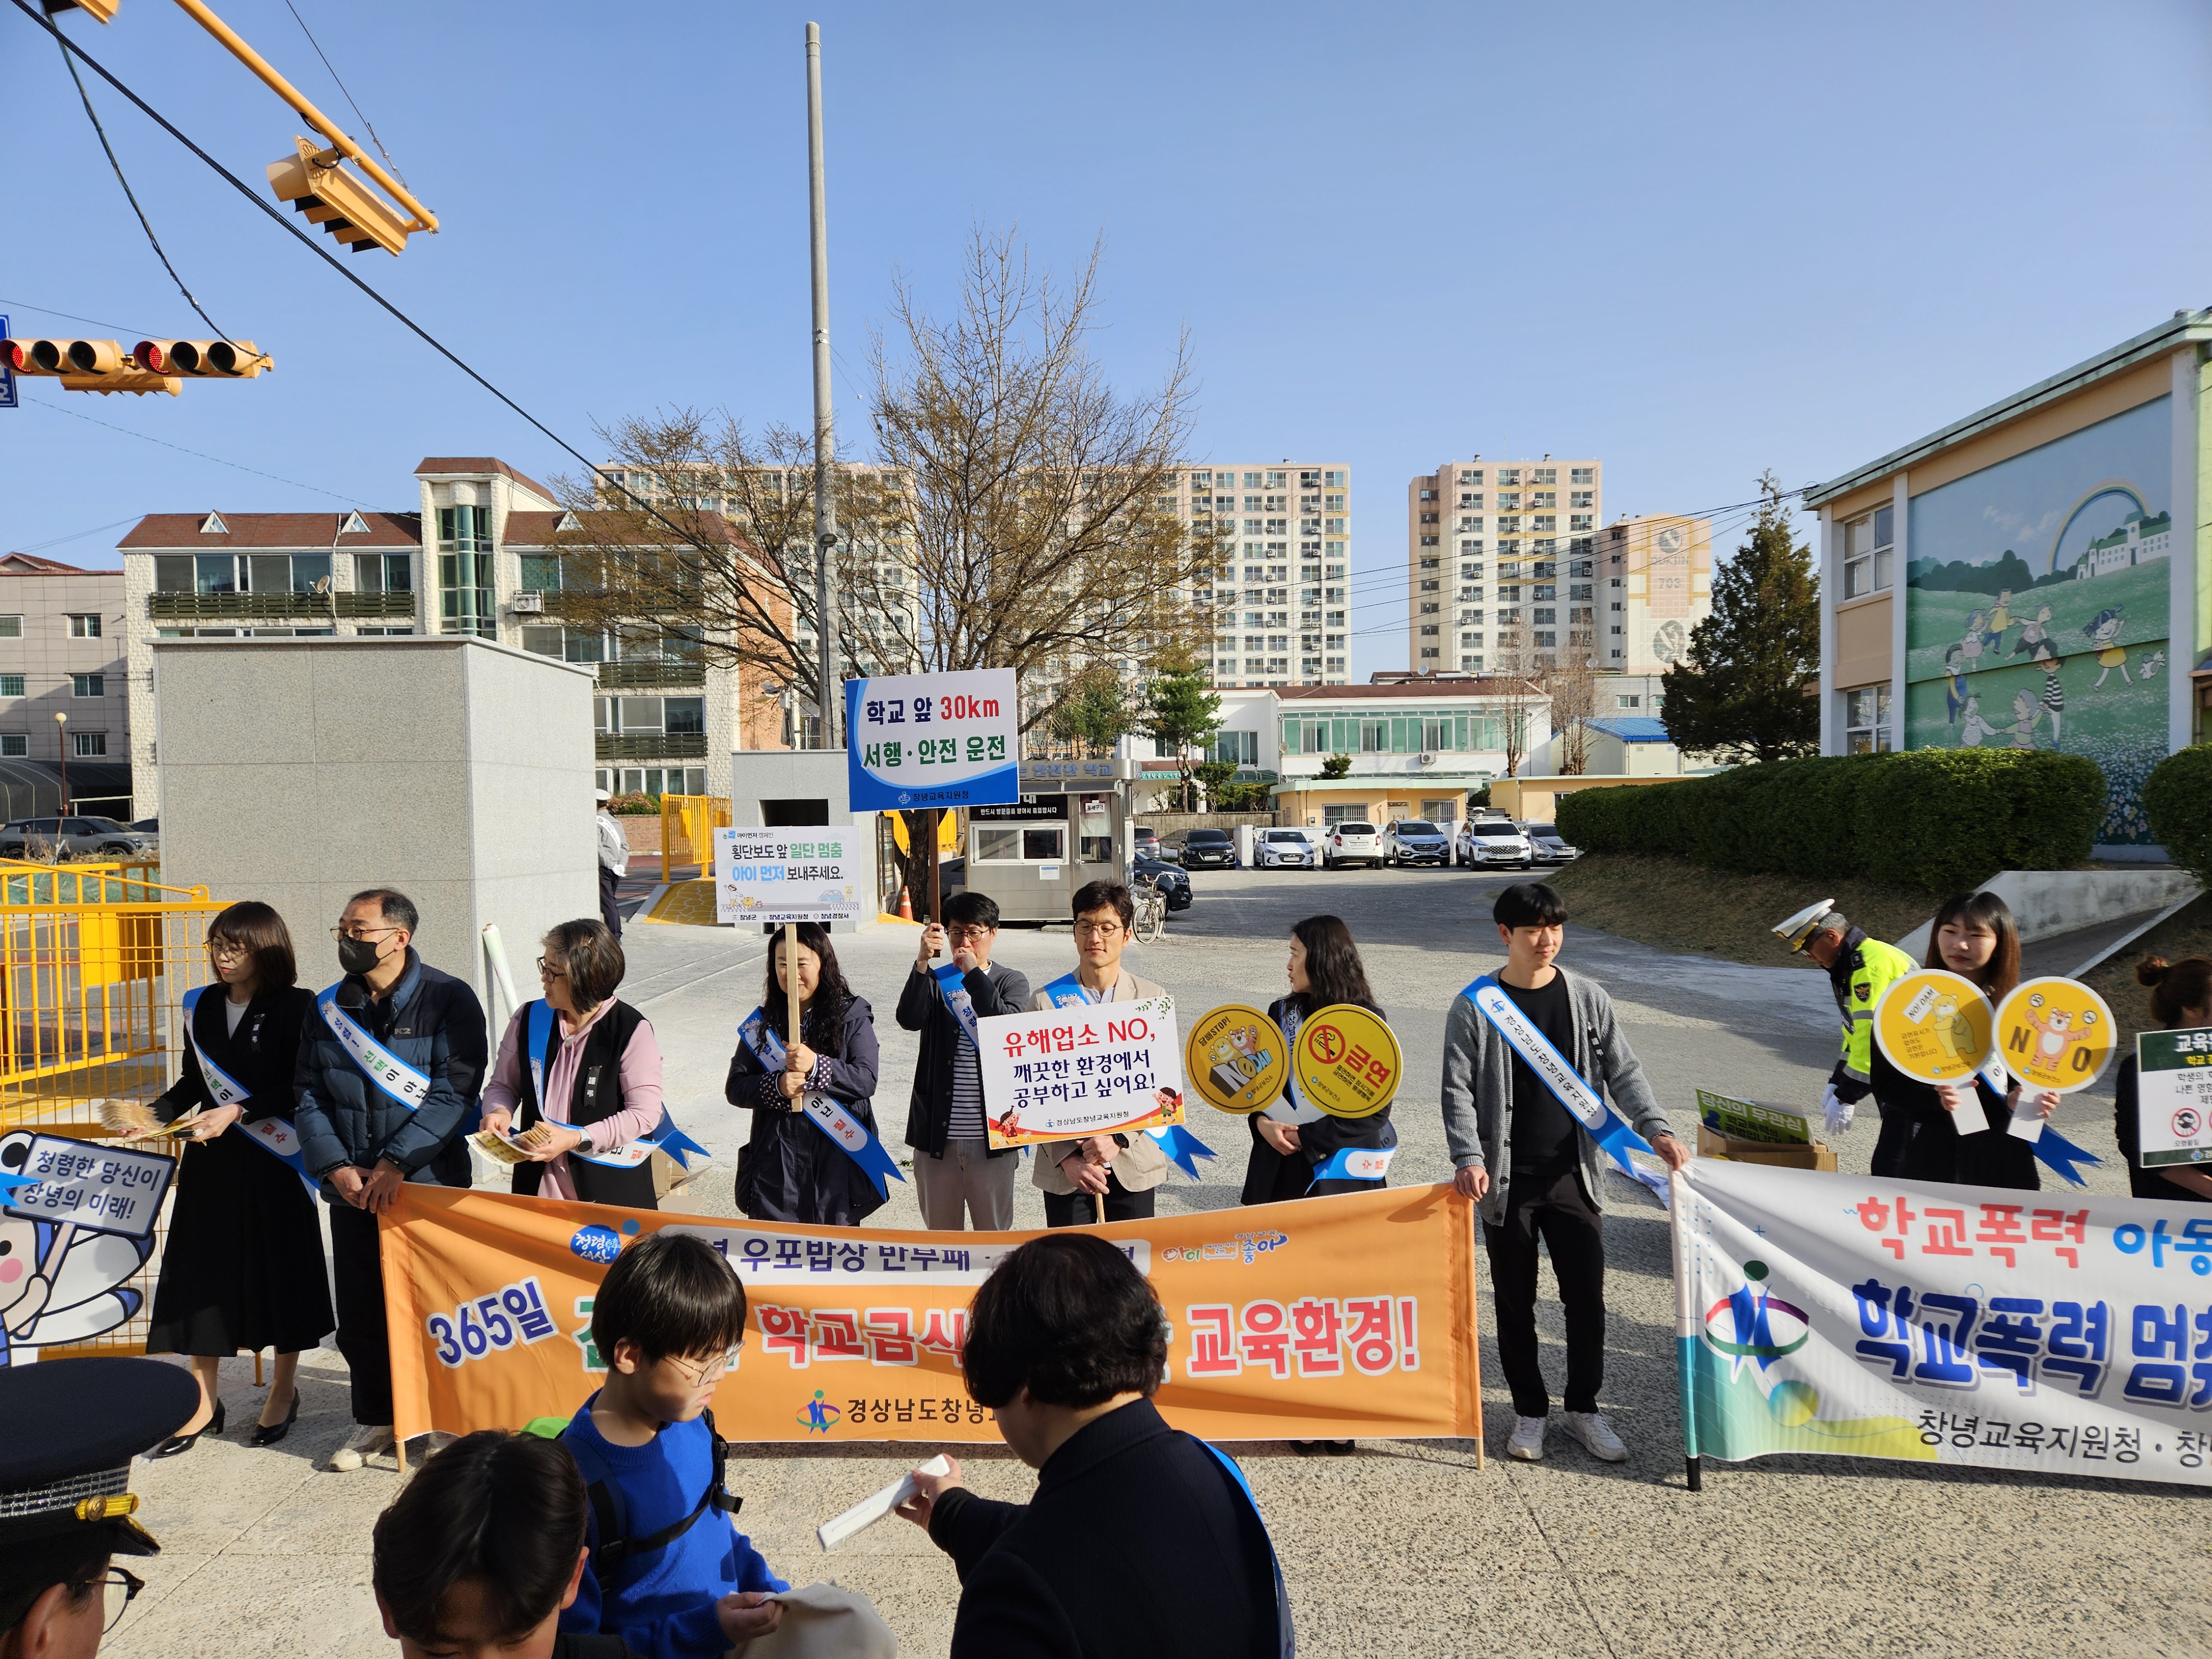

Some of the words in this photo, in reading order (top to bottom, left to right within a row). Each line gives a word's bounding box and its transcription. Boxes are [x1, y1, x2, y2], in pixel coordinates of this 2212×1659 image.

[1659, 578, 1681, 589] 703
[867, 700, 905, 725] 학교
[914, 697, 932, 723] 앞
[941, 695, 999, 719] 30km
[967, 735, 1005, 762] 운전
[1034, 764, 1077, 778] 안전한
[1084, 763, 1113, 777] 학교
[913, 791, 969, 801] 창녕교육지원청
[732, 844, 774, 860] 횡단보도
[776, 844, 787, 859] 앞
[790, 843, 815, 858] 일단
[818, 842, 842, 858] 멈춤
[732, 866, 757, 881] 아이
[760, 865, 785, 881] 먼저
[787, 865, 844, 881] 보내주세요.
[1921, 988, 1936, 1005] DAM
[1003, 1024, 1099, 1057] 유해업소
[1108, 1018, 1156, 1042] NO,
[1901, 1029, 1931, 1039] 금연표시가
[1504, 1014, 1597, 1117] 경상남도창녕교육지원청
[1908, 1048, 1937, 1060] 기본입니다
[2186, 1055, 2205, 1066] 학교
[1013, 1060, 1070, 1083] 깨끗한
[1076, 1049, 1150, 1077] 환경에서
[1344, 1044, 1391, 1089] 금연
[1941, 1061, 1971, 1072] 창녕군보건소
[2177, 1071, 2204, 1082] 학생의
[1251, 1075, 1273, 1094] 창녕군보건소
[1333, 1069, 1353, 1087] 금연하면
[2176, 1084, 2194, 1094] 나쁜
[1013, 1081, 1088, 1108] 공부하고
[1094, 1073, 1155, 1098] 싶어요!
[1317, 1081, 1340, 1102] 창녕군보건소
[811, 1096, 833, 1118] 아닌
[833, 1118, 855, 1140] 필수
[1056, 1110, 1129, 1126] 경상남도창녕교육지원청
[1700, 1092, 1747, 1118] 당신의
[1752, 1108, 1802, 1131] 무관심
[260, 1122, 287, 1144] 필수
[1726, 1114, 1778, 1136] 학교폭력의
[37, 1150, 95, 1180] 청렴한
[101, 1161, 161, 1191] 당신이
[88, 1193, 136, 1220] 미래!
[1857, 1196, 2090, 1269] 학교폭력
[580, 1249, 611, 1263] 세상
[740, 1238, 868, 1272] 우포밥상
[878, 1244, 971, 1272] 반부패
[1241, 1234, 1288, 1264] 좋아
[429, 1281, 555, 1365] 365일
[1191, 1300, 1416, 1375] 교육환경!
[1852, 1279, 2111, 1396] 학교폭력
[847, 1399, 996, 1423] 경상남도창녕
[1918, 1408, 2141, 1464] 창녕교육지원청
